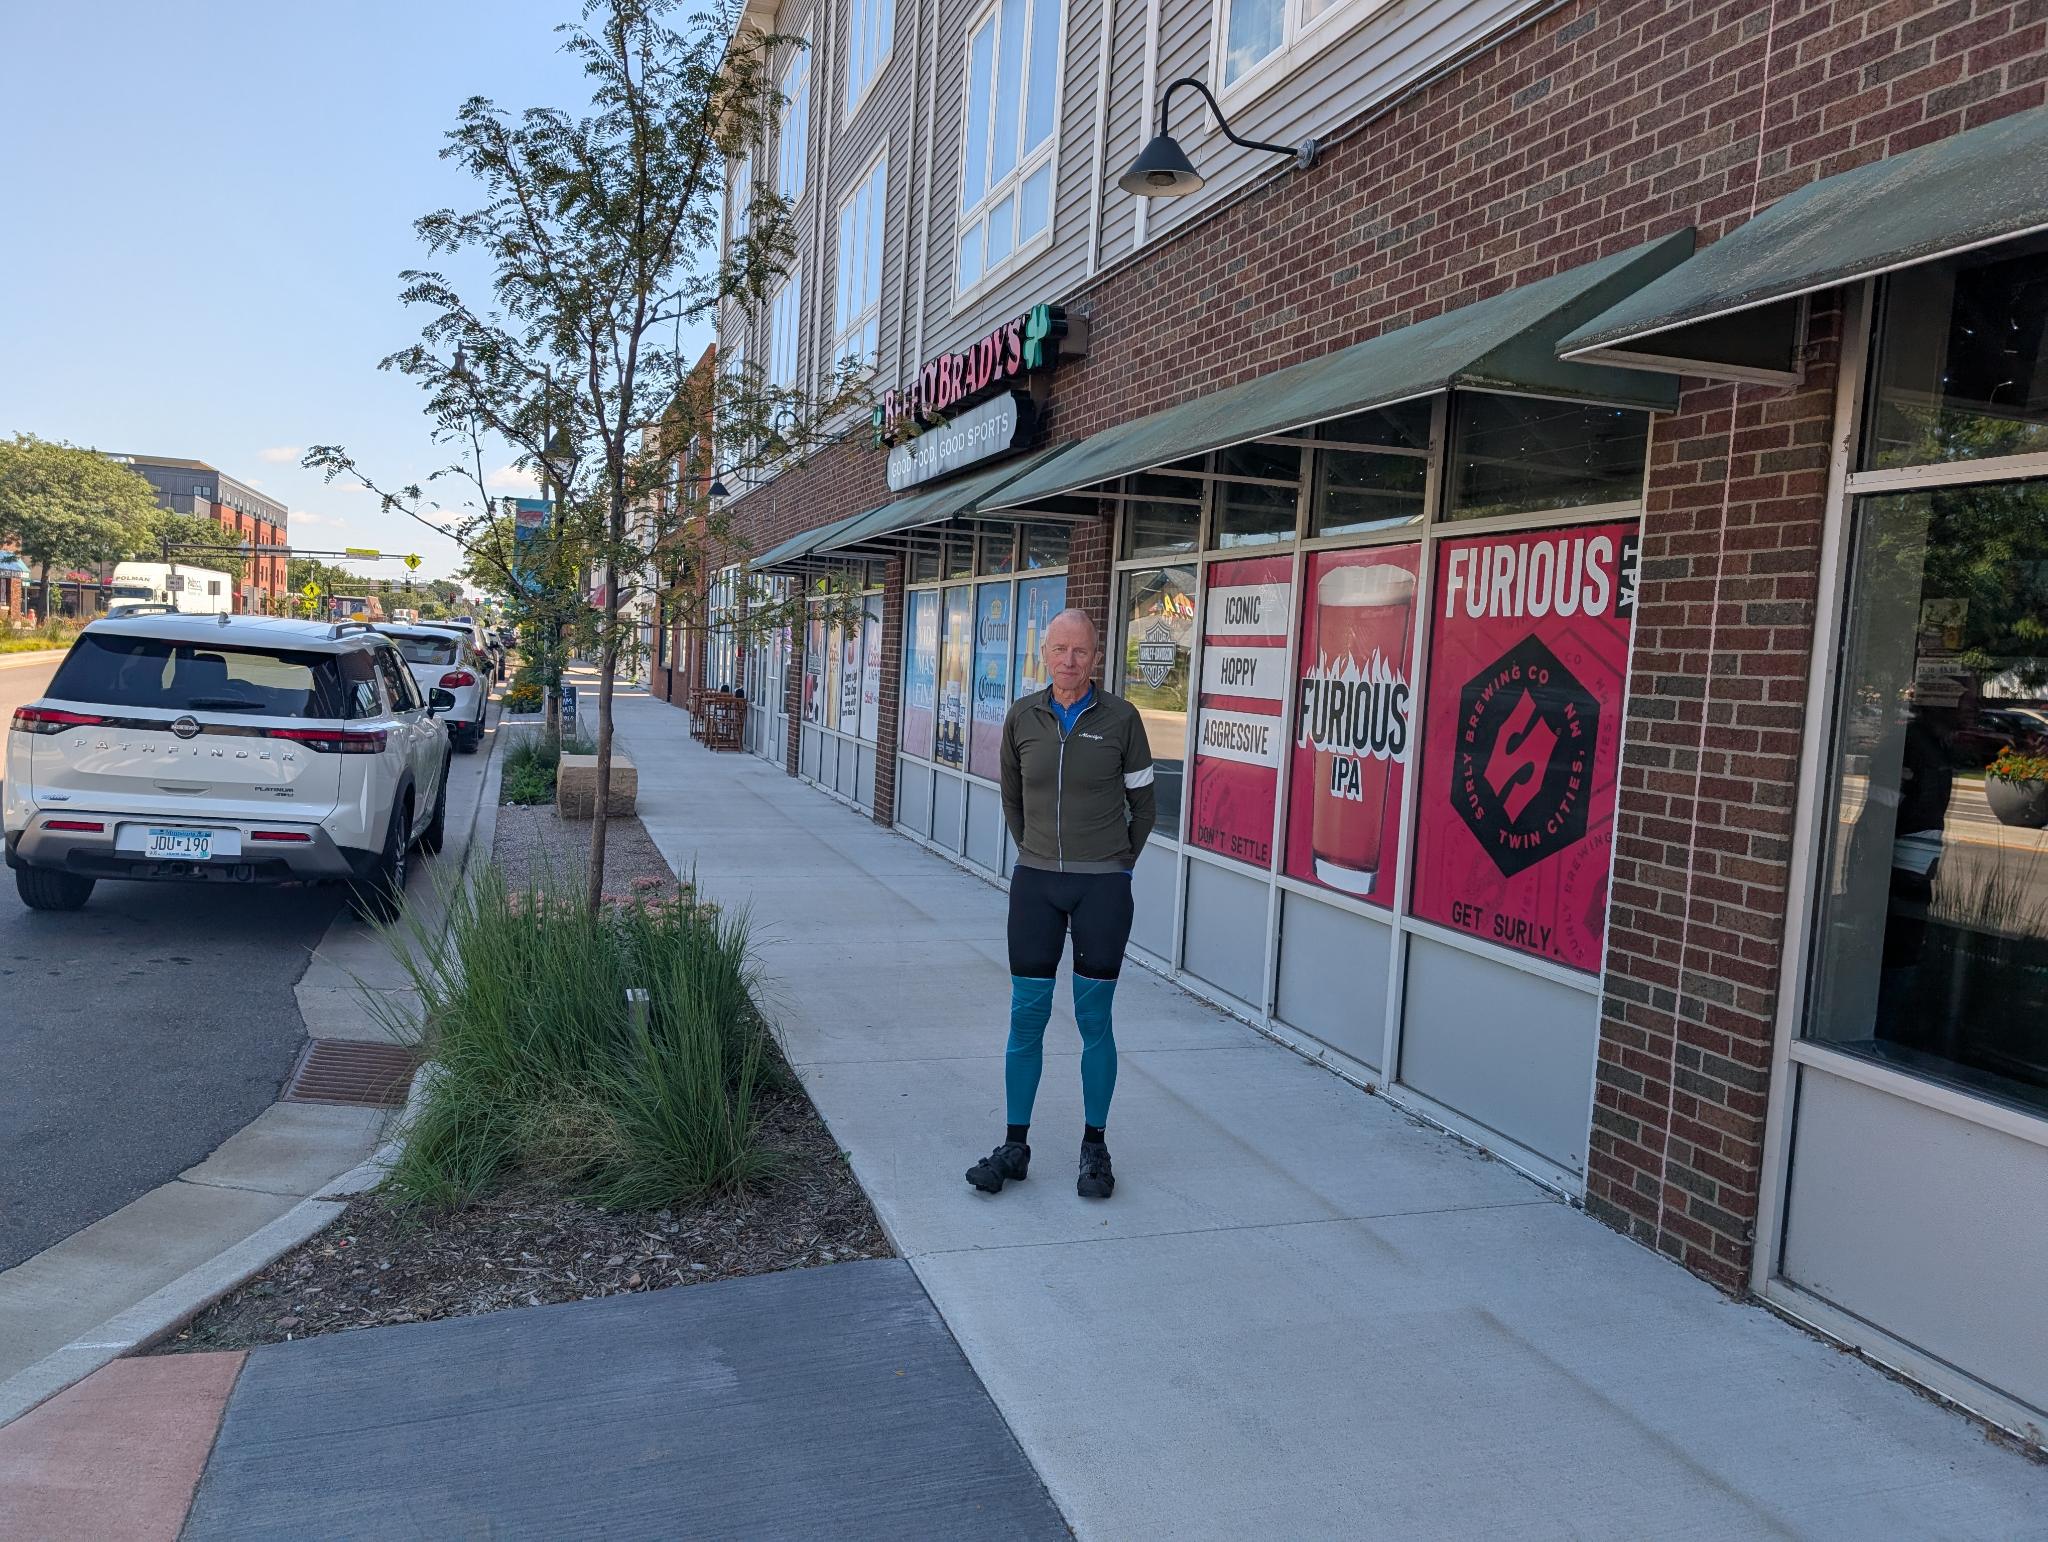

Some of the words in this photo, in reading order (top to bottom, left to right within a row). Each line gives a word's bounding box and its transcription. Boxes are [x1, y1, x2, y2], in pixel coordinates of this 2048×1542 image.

[892, 458, 912, 478] GOOD
[913, 447, 937, 470] FOOD,
[939, 433, 965, 459] GOOD
[967, 412, 1008, 447] SPORTS
[1446, 535, 1613, 619] FURIOUS
[1619, 544, 1639, 607] IPA
[923, 596, 935, 617] LA
[1224, 596, 1261, 625] ICONIC
[978, 674, 1006, 702] Corona
[1220, 656, 1257, 687] HOPPY
[1528, 665, 1549, 684] CO
[977, 702, 1005, 722] PREMIER
[1299, 678, 1409, 755] FURIOUS
[1466, 665, 1521, 744] BREWING
[1564, 702, 1582, 738] MN
[74, 739, 295, 761] PATHFINDER
[1202, 718, 1270, 755] AGGRESSIVE
[1331, 757, 1360, 796] IPA
[1463, 752, 1485, 820] SURLY
[1547, 750, 1585, 834] CITIES,
[150, 836, 175, 851] JDU
[184, 838, 209, 852] 190
[1198, 825, 1225, 849] DON'T
[1231, 835, 1272, 865] SETTLE.
[1499, 829, 1542, 849] TWIN
[1452, 900, 1483, 930] GET
[1493, 913, 1559, 955] SURLY.
